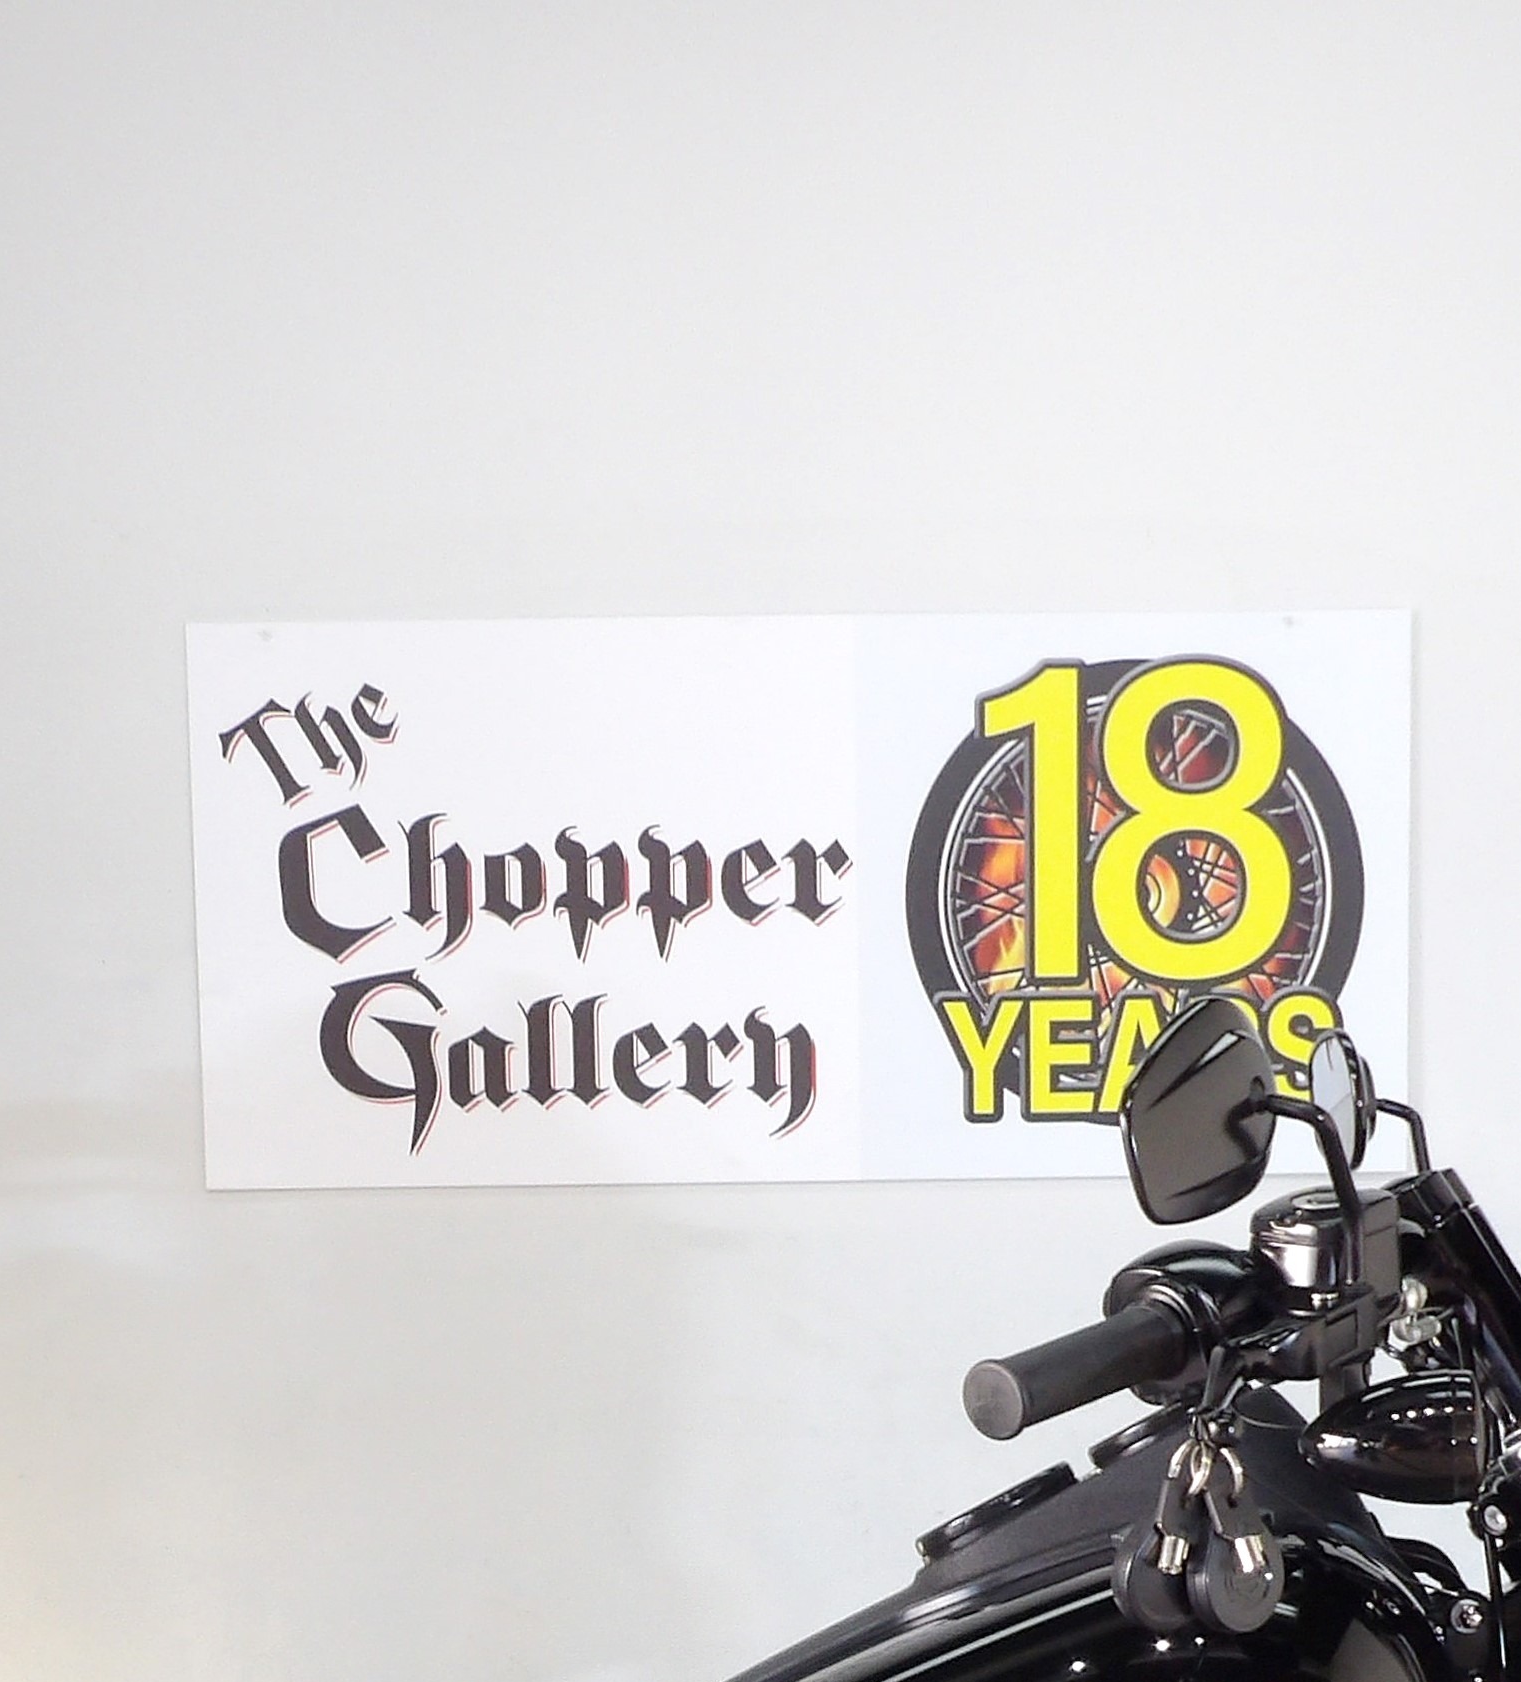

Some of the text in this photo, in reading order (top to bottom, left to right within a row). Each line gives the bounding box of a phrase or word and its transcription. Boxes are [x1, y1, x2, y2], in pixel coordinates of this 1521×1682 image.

[218, 679, 400, 806] The
[979, 658, 1295, 985] 18
[278, 805, 854, 964] Chopper
[318, 969, 817, 1156] Gallery
[940, 992, 1339, 1117] YEAS
